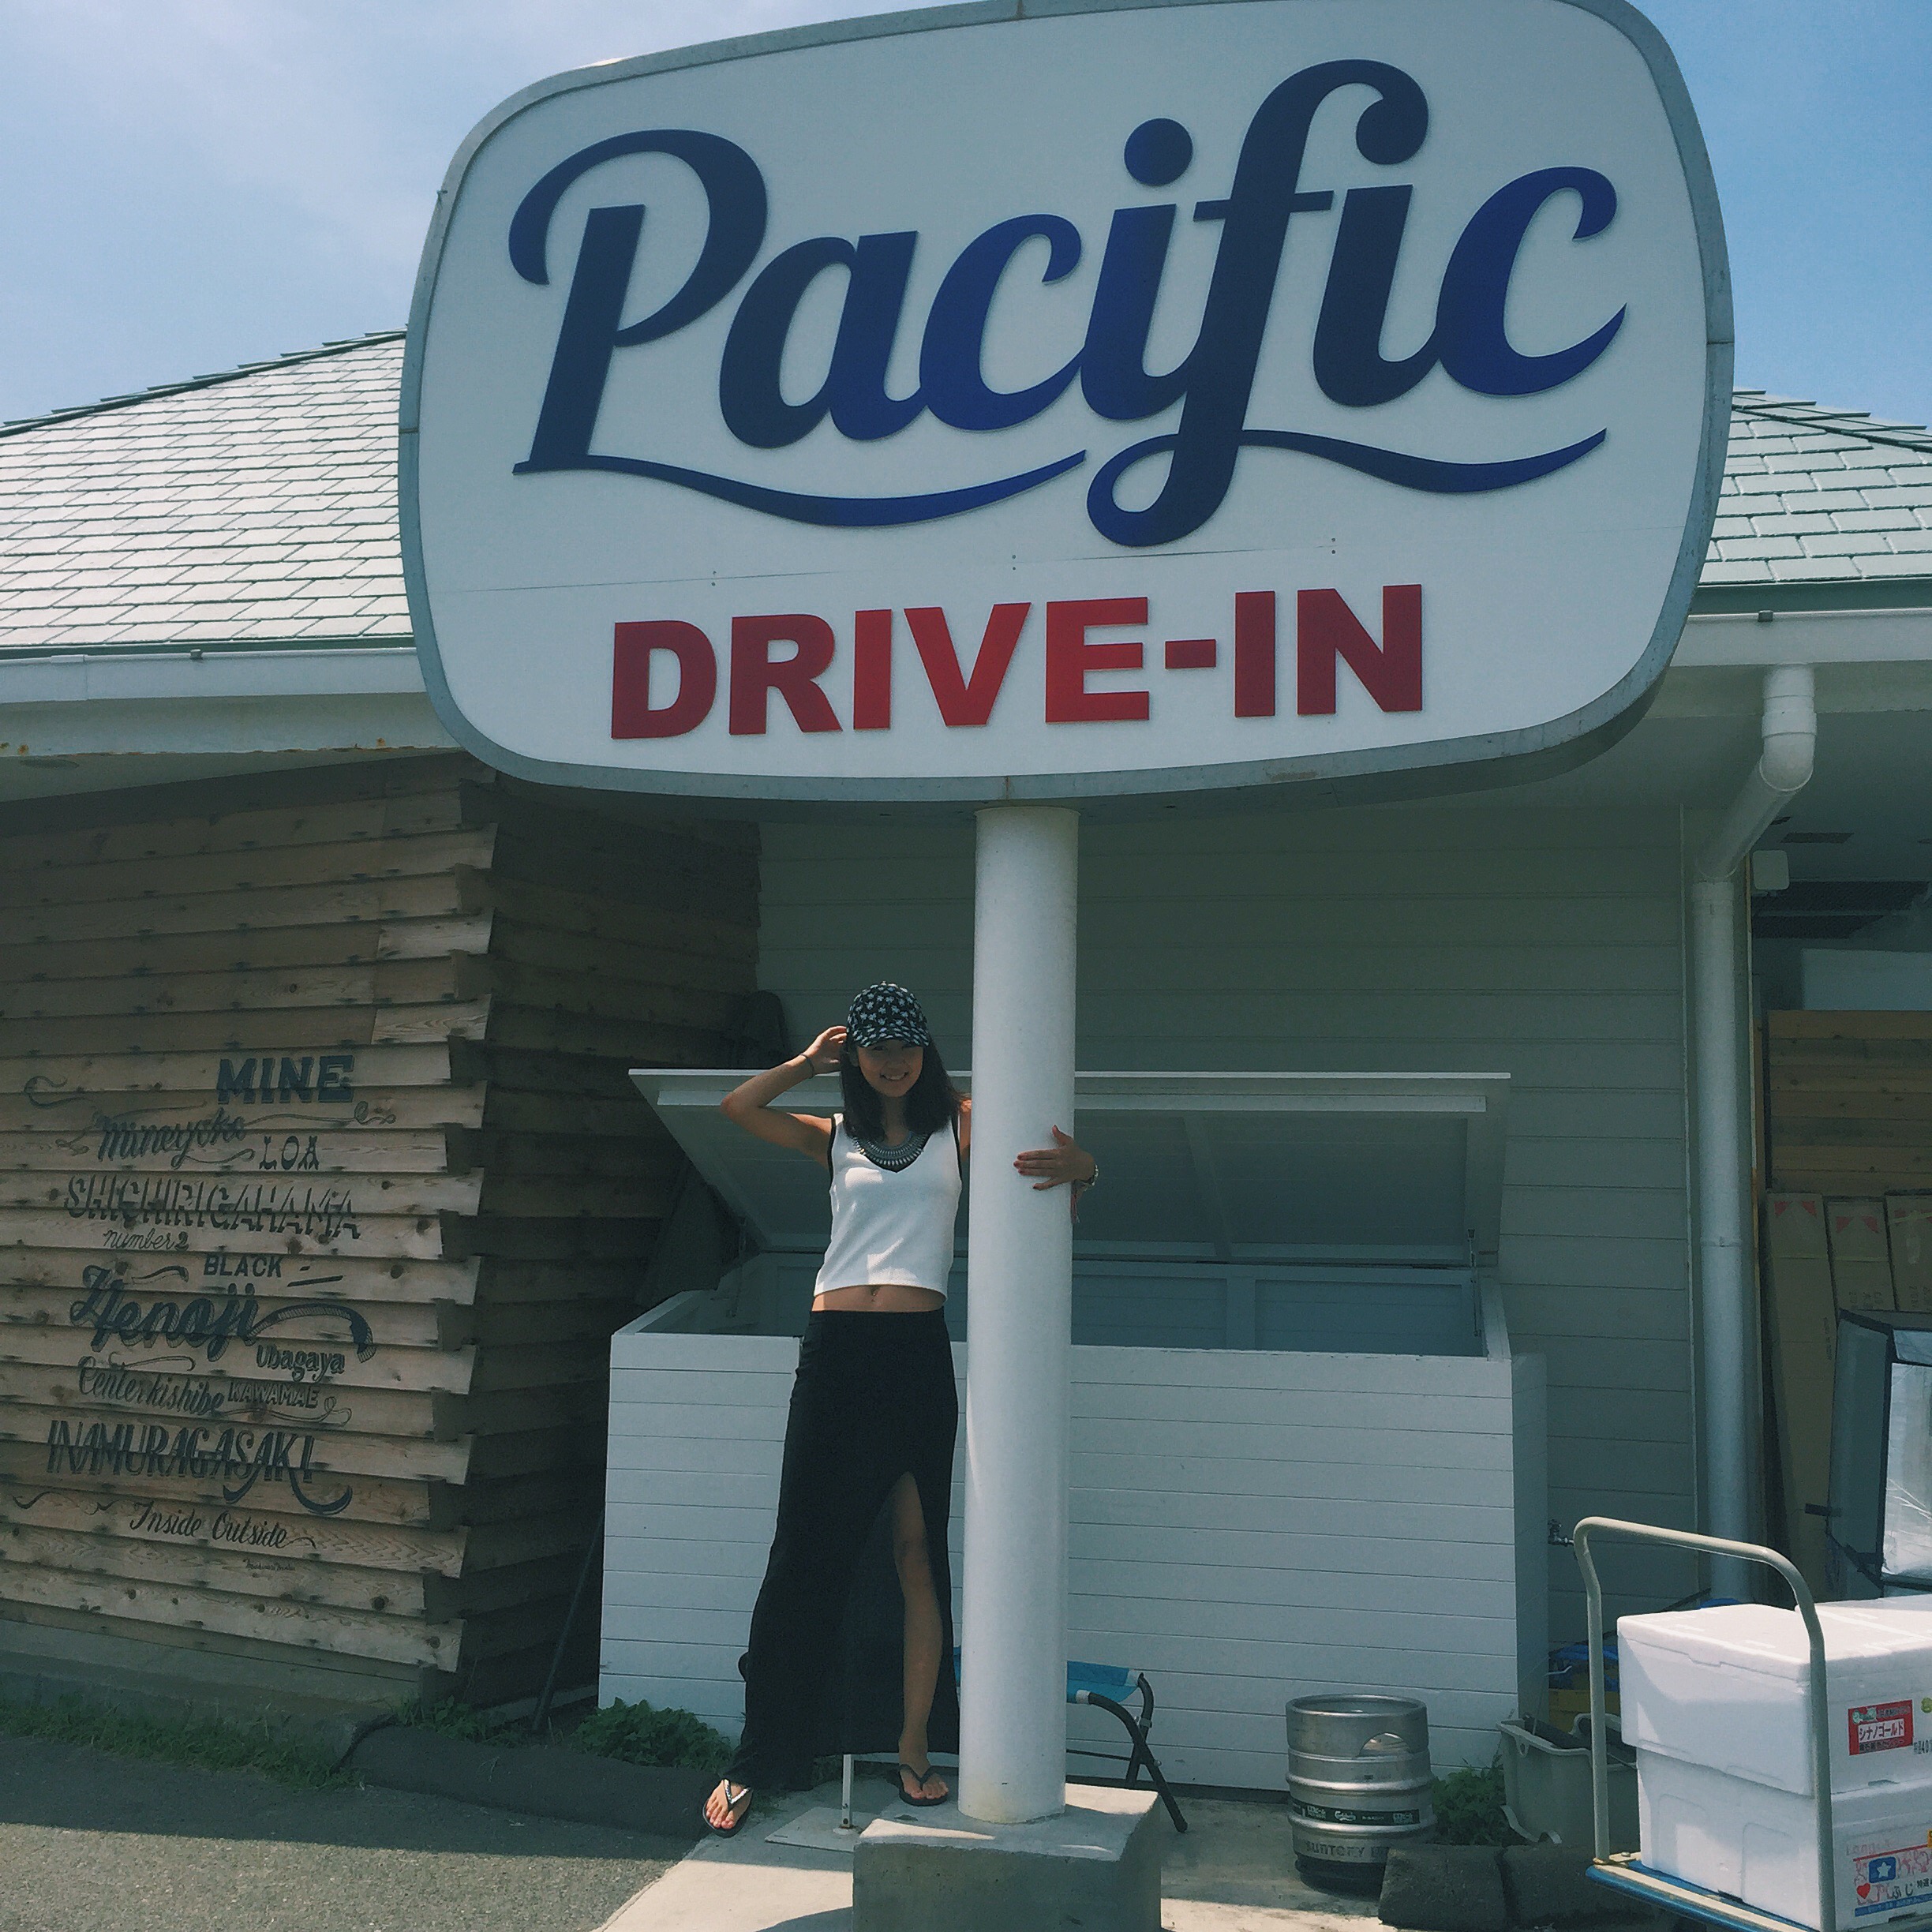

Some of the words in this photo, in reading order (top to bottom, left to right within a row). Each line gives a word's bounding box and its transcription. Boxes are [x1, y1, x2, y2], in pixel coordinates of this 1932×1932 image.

[508, 58, 1627, 548] Pacific
[611, 584, 1424, 741] DRIVE-IN
[216, 1054, 354, 1104] MINE
[260, 1135, 320, 1171] LOA
[203, 1253, 283, 1278] BLACK
[256, 1345, 346, 1383] Ubagaya
[227, 1380, 320, 1410] KAWAMAE
[46, 1418, 352, 1515] INAMURAGASAKI
[129, 1501, 203, 1538] Inside
[212, 1512, 289, 1549] Outside
